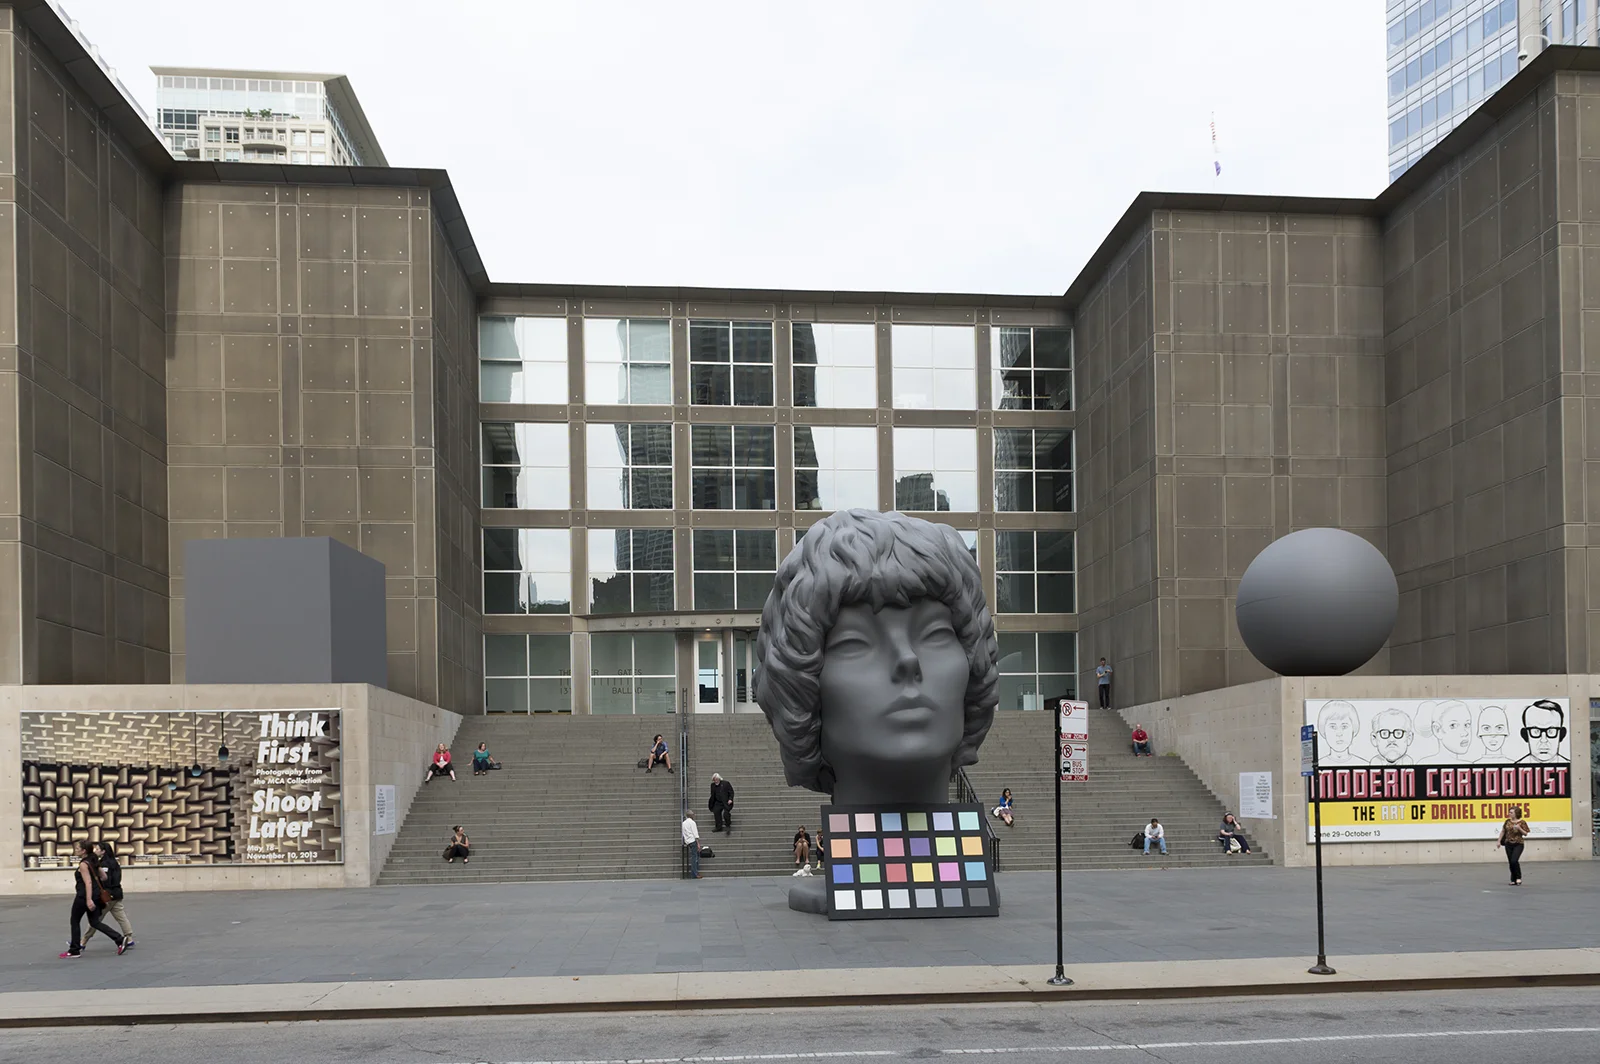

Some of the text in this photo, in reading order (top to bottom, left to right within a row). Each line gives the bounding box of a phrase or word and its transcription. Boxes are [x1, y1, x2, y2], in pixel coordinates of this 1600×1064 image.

[618, 668, 642, 676] GATES
[612, 687, 642, 695] BALLAD
[259, 712, 326, 737] Think
[257, 739, 311, 763] First
[256, 768, 303, 776] Photography
[1311, 767, 1568, 798] MODERN CARTOONIST
[252, 788, 321, 813] Shoot
[1353, 802, 1530, 821] THE ART OF DANIEL CLOWS
[249, 816, 313, 839] Later
[246, 844, 263, 853] May
[246, 851, 318, 860] November 10, 2013
